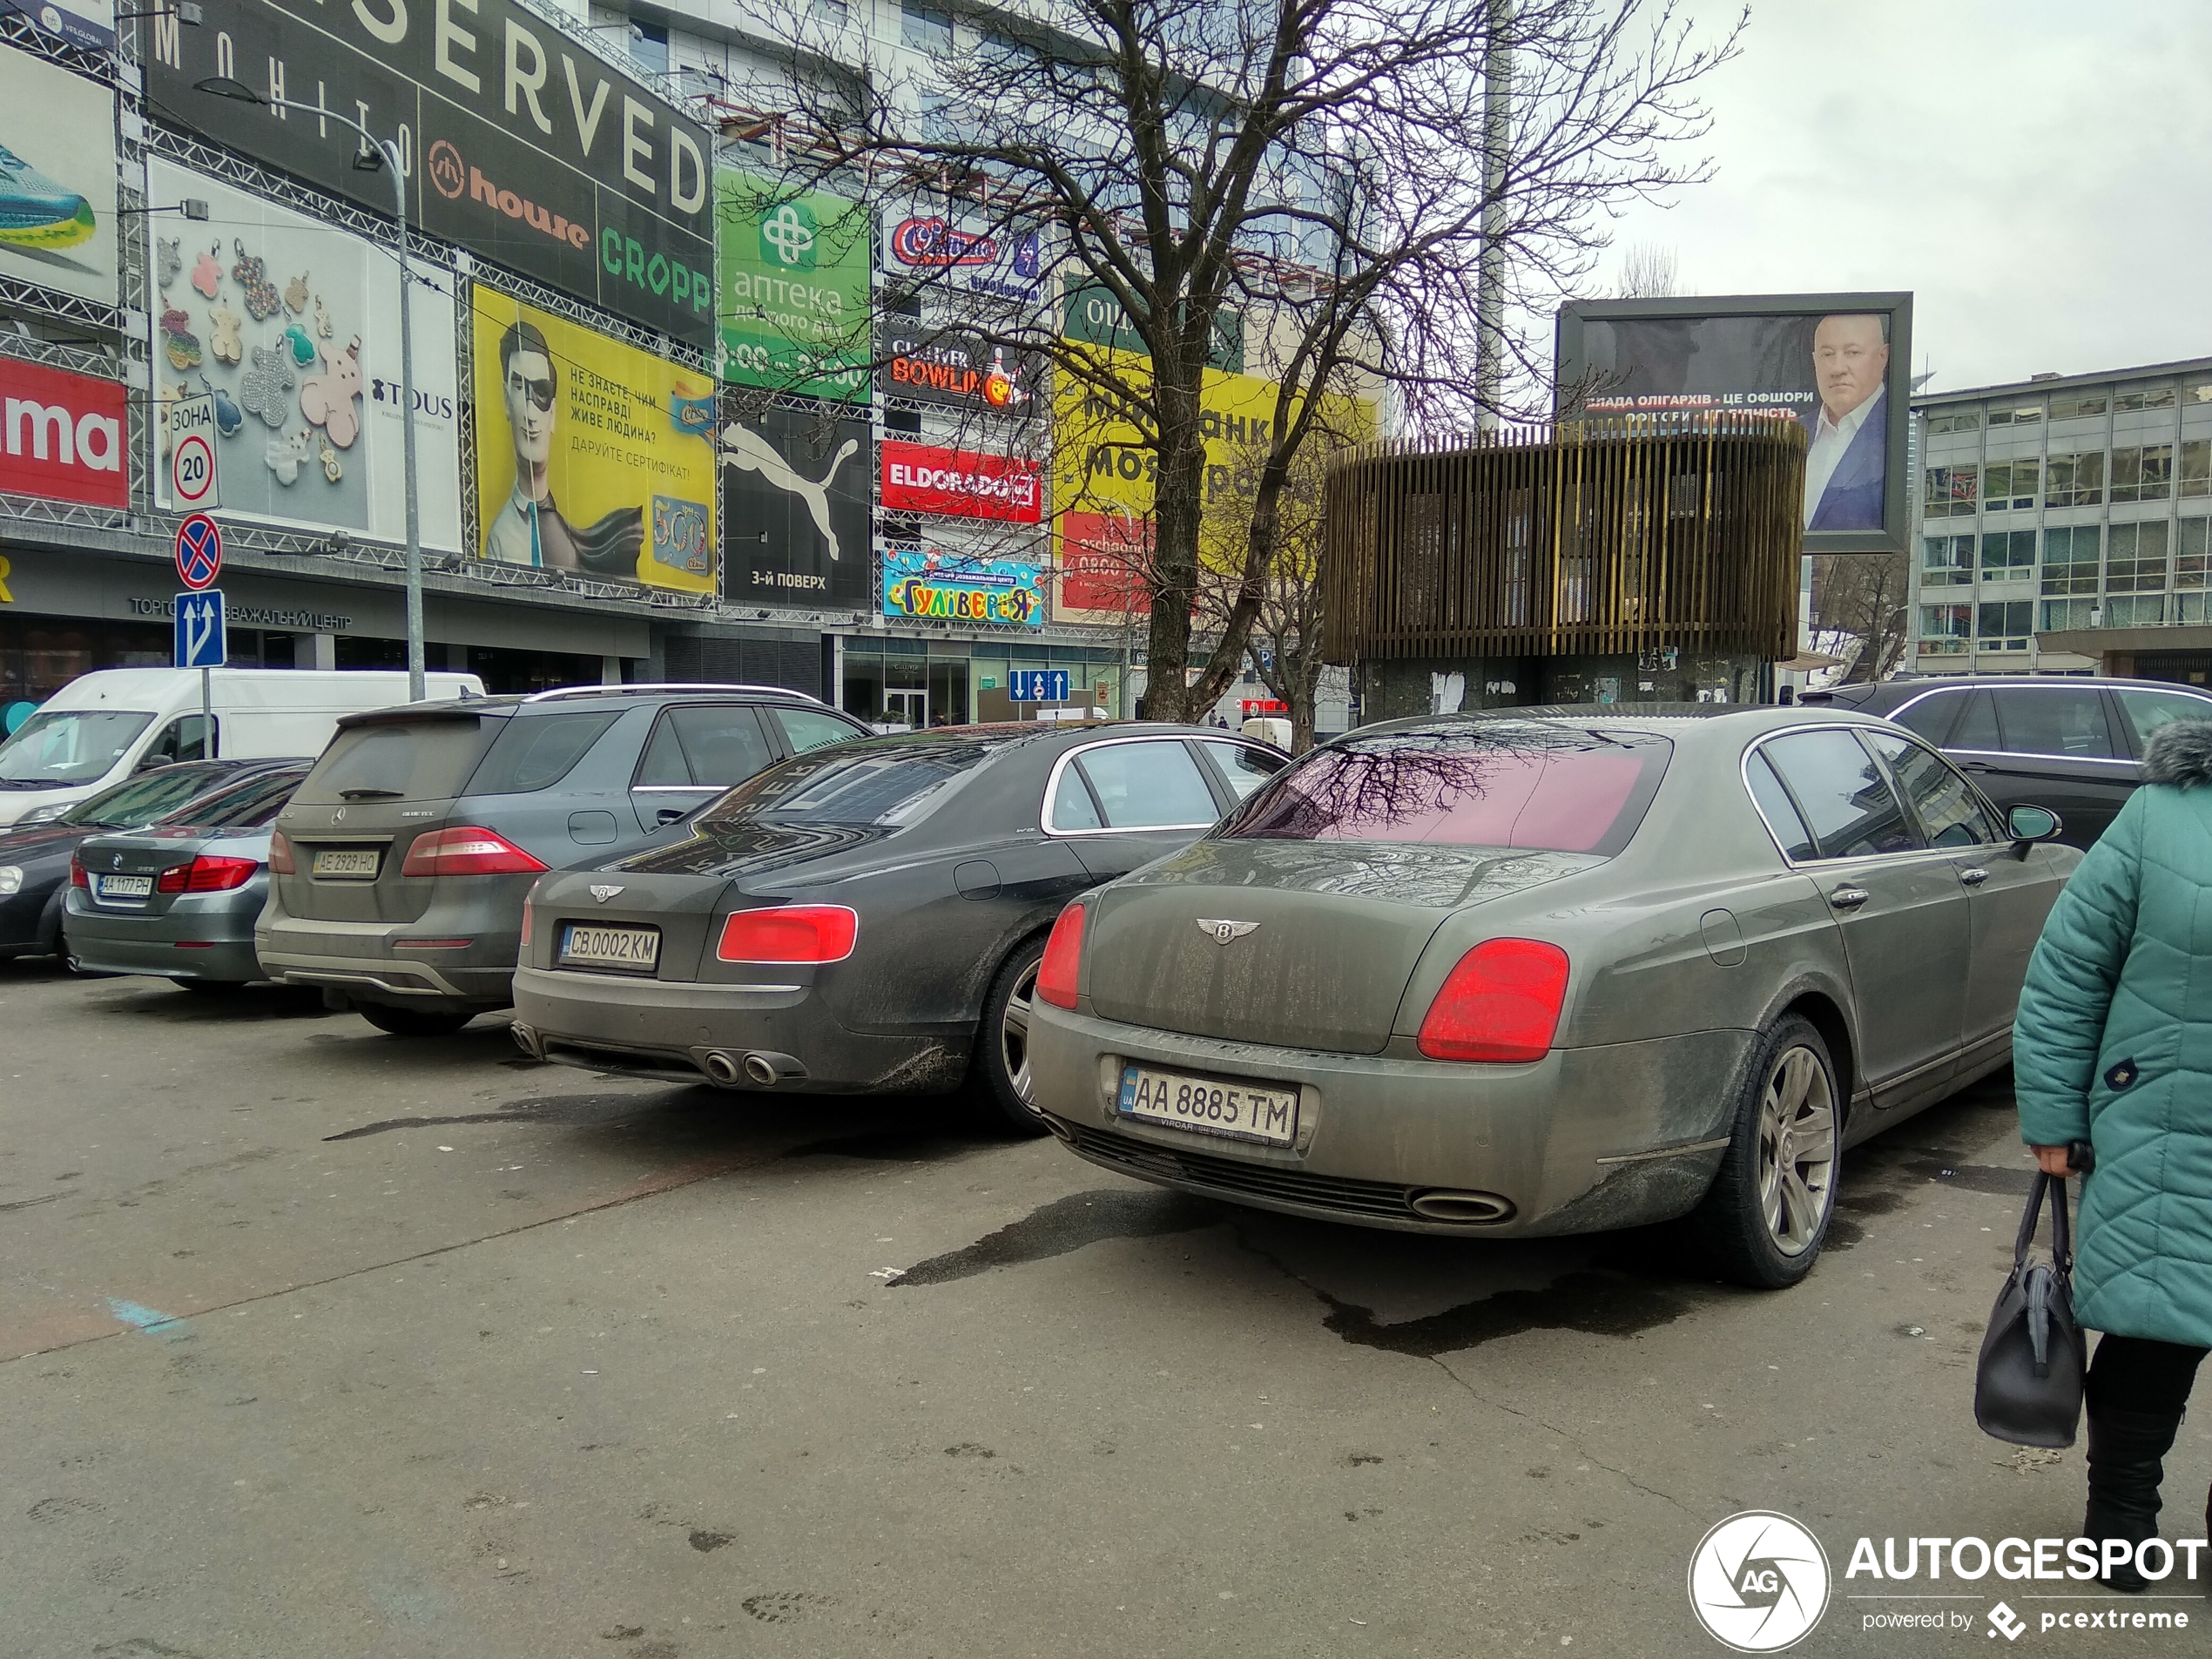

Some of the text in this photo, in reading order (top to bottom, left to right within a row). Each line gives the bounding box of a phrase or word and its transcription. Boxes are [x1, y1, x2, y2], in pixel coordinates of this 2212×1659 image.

[470, 165, 590, 250] house
[601, 226, 711, 314] CROPP
[734, 272, 841, 315] аптека
[570, 368, 584, 385] НЕ
[635, 390, 656, 409] ЧИМ
[570, 387, 631, 420] НАСПРАВДІ
[1637, 394, 1712, 406] ОЛІГАРХІВ
[1723, 394, 1743, 404] ЦЕ
[1747, 392, 1814, 403] ОФШОРИ
[172, 404, 212, 431] ЗОНА
[570, 406, 656, 444] ЖИВЕ ЛЮДИНА?
[1199, 409, 1271, 446] анк
[182, 455, 204, 482] 20
[571, 436, 690, 481] ДАРУЙТЕ СЕРТИФІКАТ!
[890, 463, 1009, 496] ELDORADO
[752, 570, 826, 590] 3-й ПОВЕРХ
[315, 614, 352, 631] ЦЕНТР
[320, 854, 374, 871] AE 2929 HO
[104, 877, 114, 890] AA
[117, 878, 135, 892] 1177
[631, 934, 655, 960] KM
[1123, 1097, 1132, 1106] UA
[1135, 1078, 1290, 1134] AA 8885 TM
